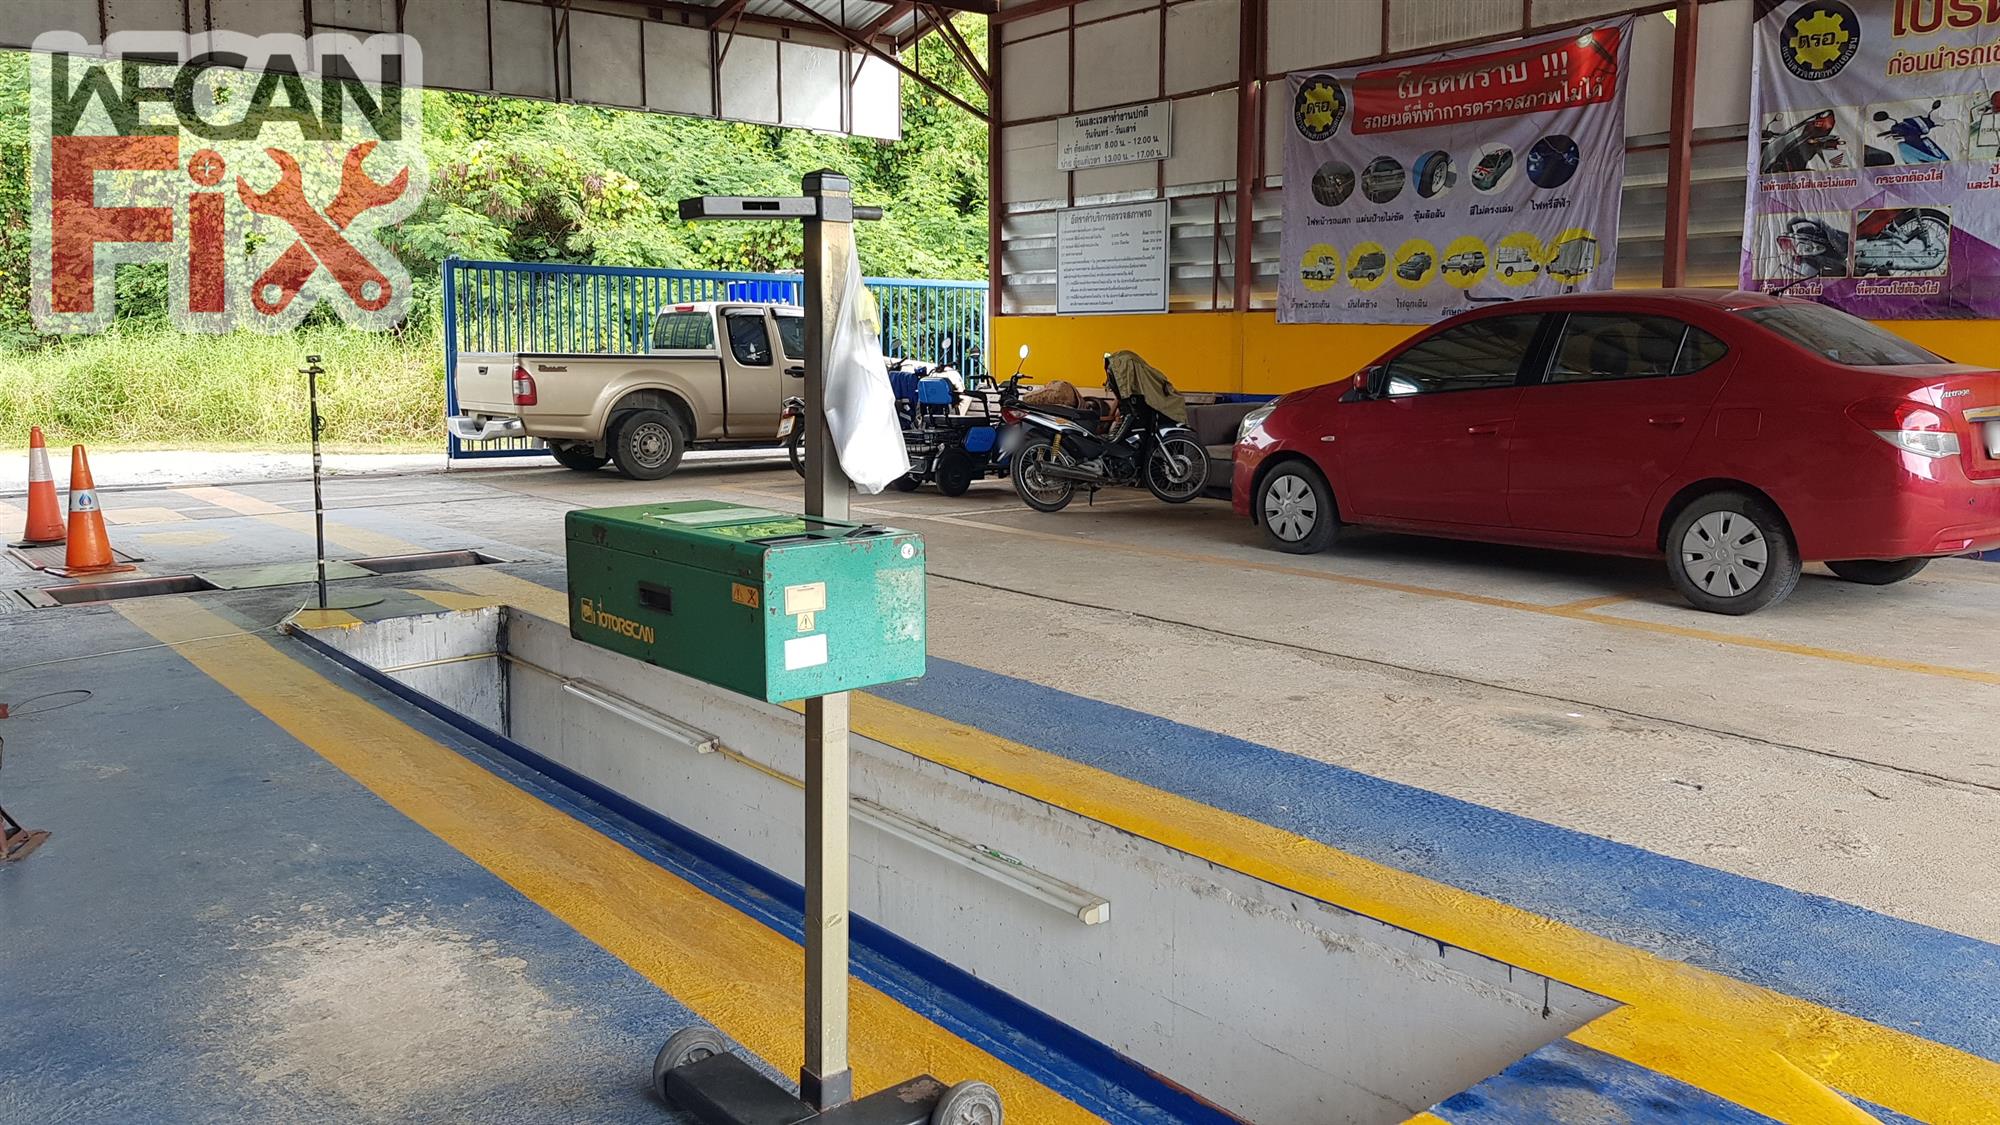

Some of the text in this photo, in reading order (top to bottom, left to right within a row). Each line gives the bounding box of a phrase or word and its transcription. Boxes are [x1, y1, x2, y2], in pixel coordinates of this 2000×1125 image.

[1798, 32, 1840, 48] ตรอ.
[1396, 51, 1569, 99] โปรดทราบ !!!
[1362, 77, 1604, 129] รถยนต์ที่ทำการตรวจสภาพไม่ได้
[1074, 106, 1149, 128] วันและเวลาทำงานปกติ
[1085, 127, 1109, 139] วันจันทร์
[1115, 122, 1136, 135] วันเสาร์
[1104, 141, 1118, 149] 8.00
[1133, 136, 1152, 146] 12.00
[1104, 153, 1121, 163] 13.00
[1136, 149, 1155, 159] 17.00
[1875, 168, 1944, 185] กระจกต้องใส่
[1355, 211, 1404, 224] แผ่นป้ายไม่ชัด
[1469, 203, 1514, 216] สีไม่ตรงเล่ม
